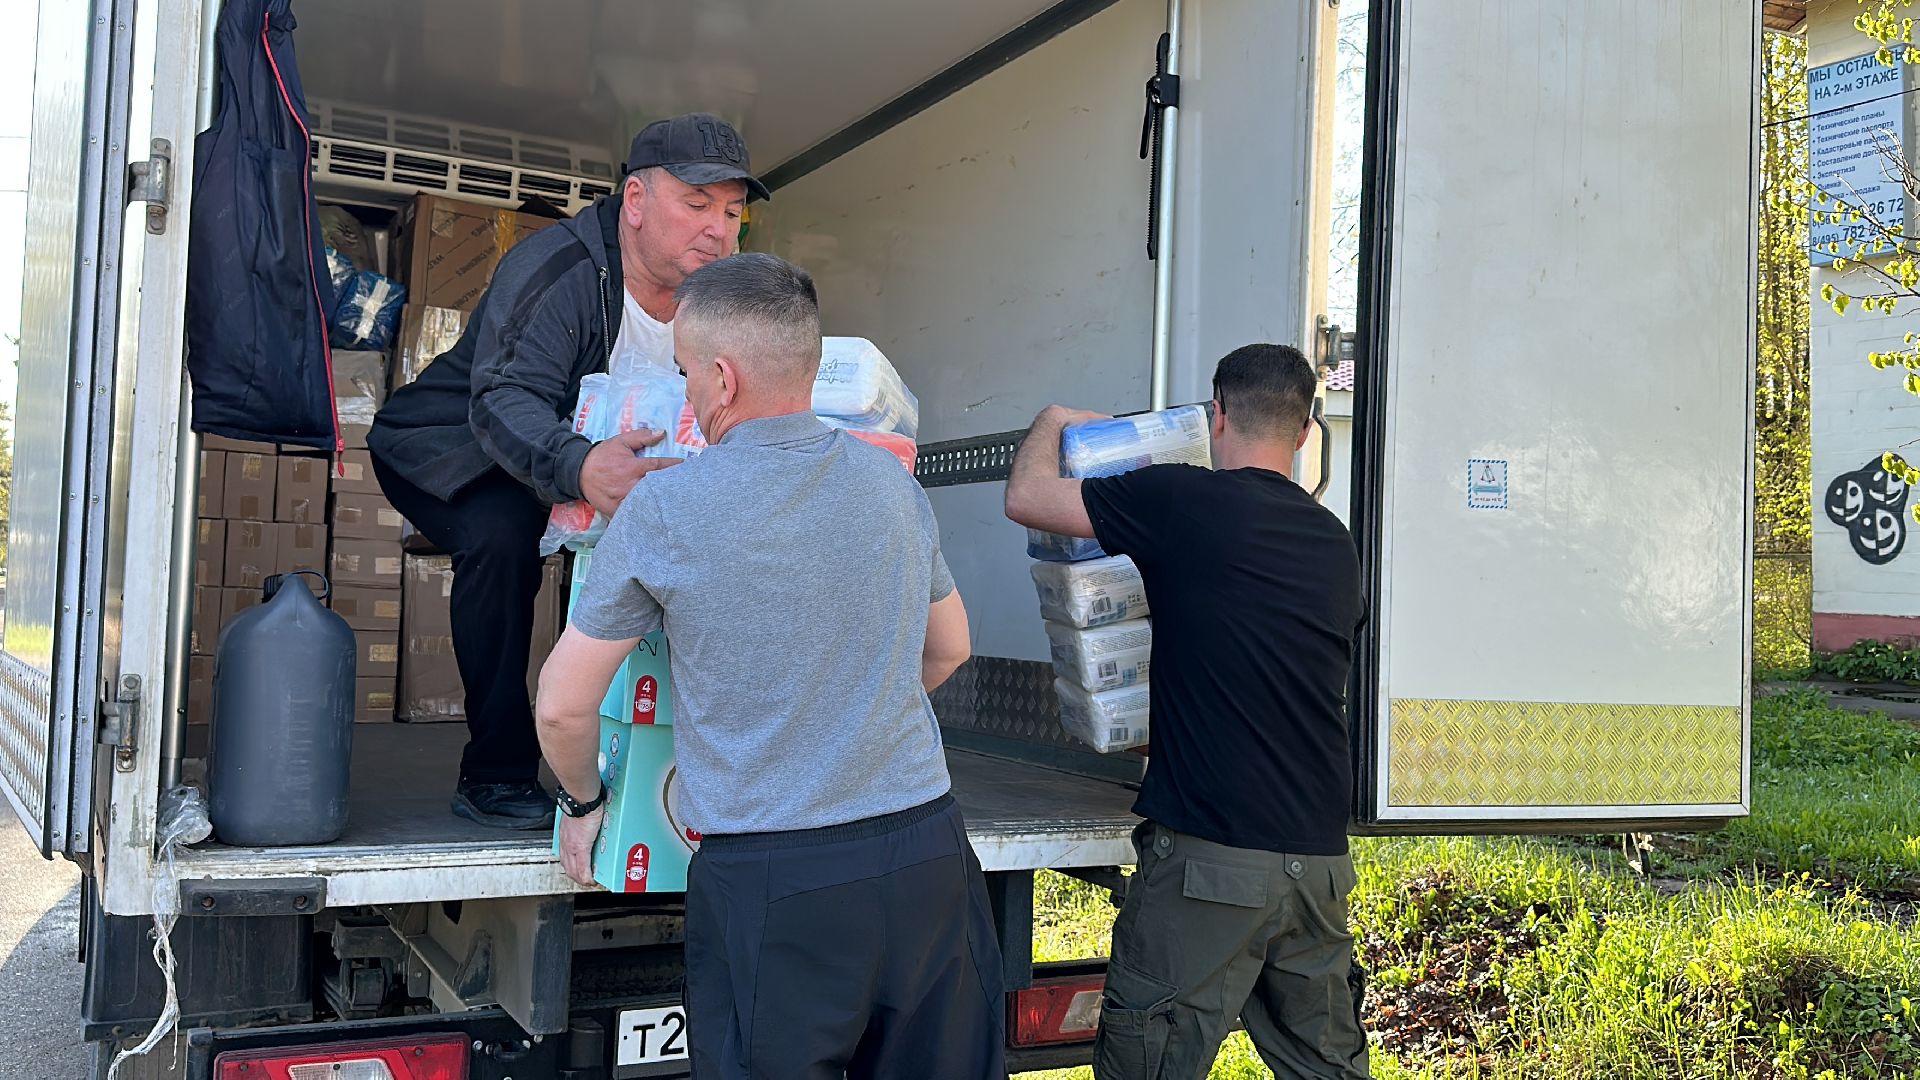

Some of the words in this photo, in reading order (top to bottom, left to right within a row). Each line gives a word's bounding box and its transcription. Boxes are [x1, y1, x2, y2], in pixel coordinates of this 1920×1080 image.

[1810, 68, 1831, 84] МЫ
[1837, 49, 1903, 76] ОСТАЛЬ
[1814, 86, 1831, 100] НА
[1833, 82, 1852, 96] 2-м
[1856, 68, 1899, 89] ЭТАЖЕ
[1816, 117, 1860, 132] Технические
[1861, 110, 1886, 122] планы
[1816, 129, 1860, 143] Технические
[1861, 120, 1895, 134] паспорта
[1817, 140, 1862, 156] Кадастровые
[1817, 153, 1861, 168] Составление
[1817, 165, 1855, 179] Экспертиза
[1888, 198, 1903, 213] 72
[1812, 232, 1840, 247] 8(495)
[1842, 224, 1865, 241] 782
[642, 680, 651, 693] 4
[633, 848, 644, 861] 4
